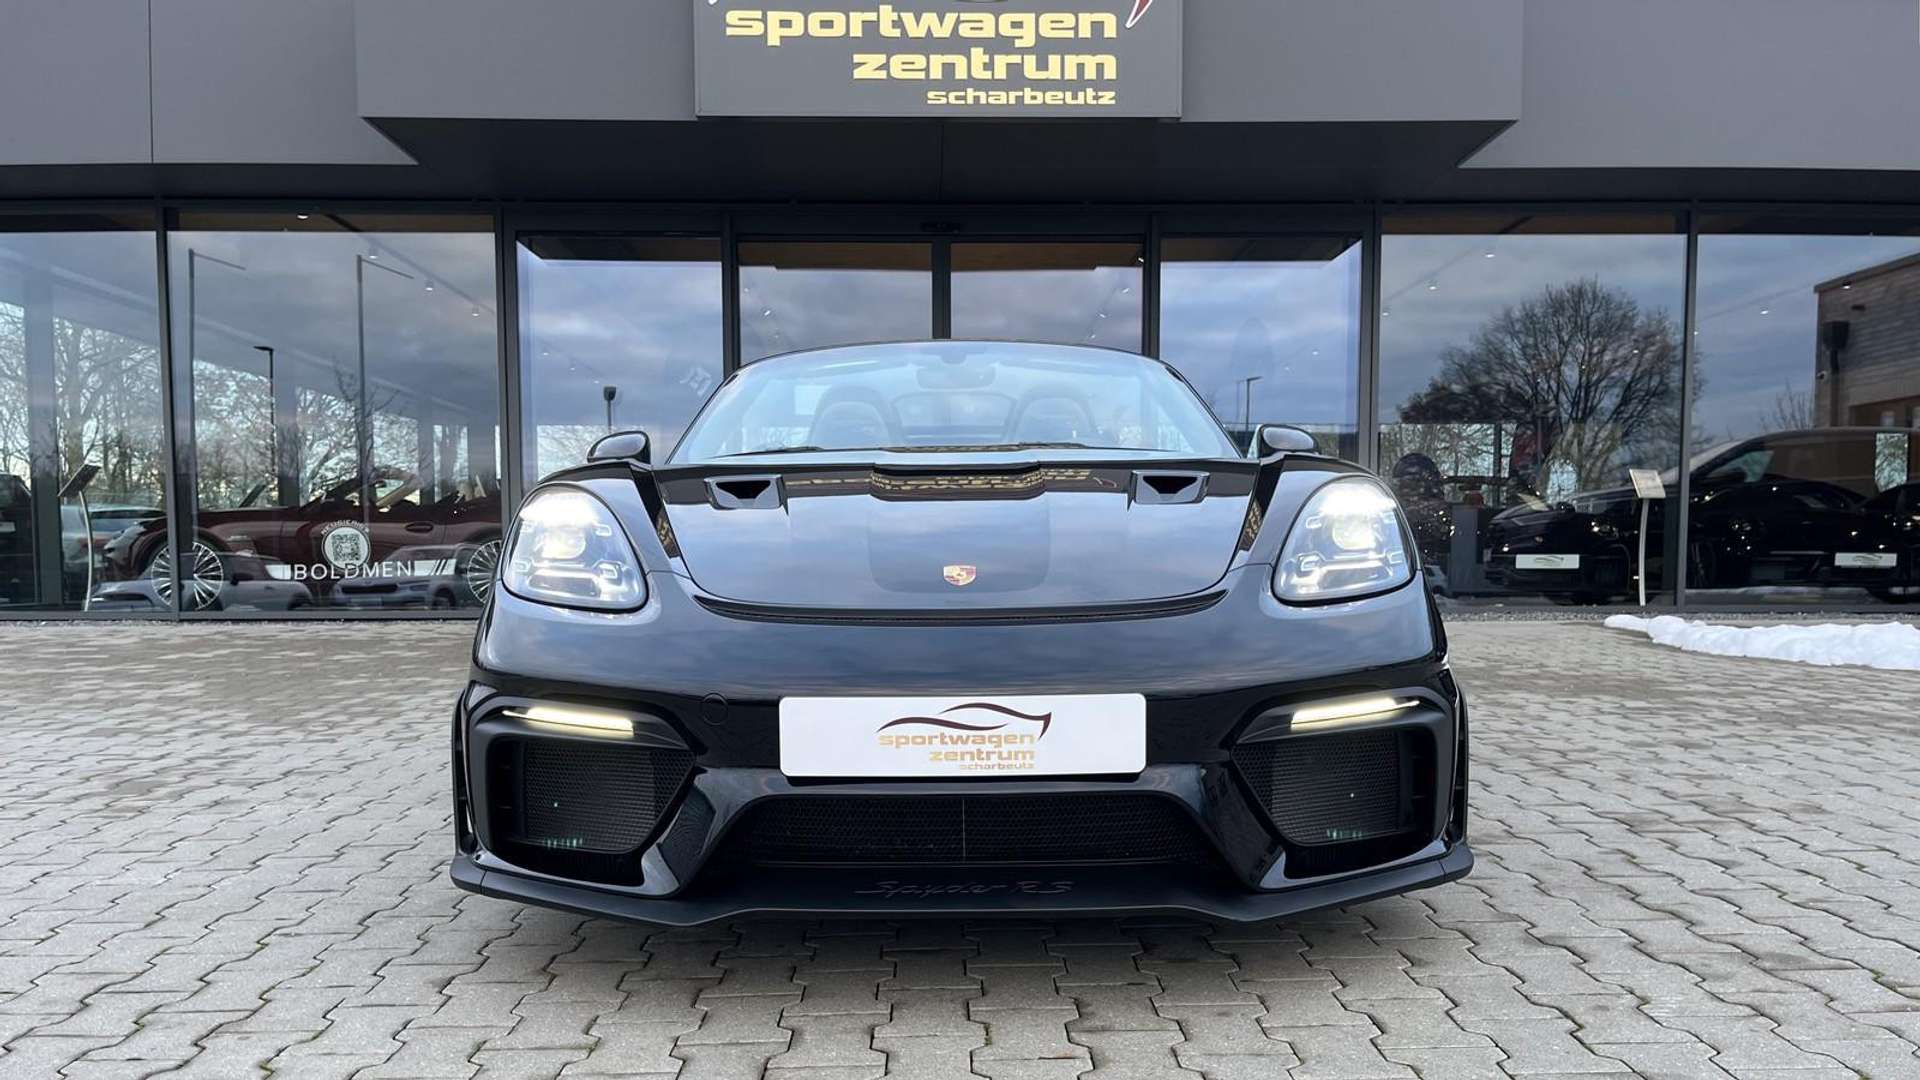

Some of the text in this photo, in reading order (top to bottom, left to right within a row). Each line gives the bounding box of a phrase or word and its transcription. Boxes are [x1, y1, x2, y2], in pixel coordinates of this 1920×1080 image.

[726, 5, 1117, 47] sportwagen
[853, 48, 1117, 80] zentrum
[927, 88, 1116, 105] scharbeutz
[294, 562, 412, 580] BOLDMEN
[878, 732, 1035, 749] sportwagen
[929, 748, 1035, 761] zentrum
[959, 762, 1034, 770] scharbeutz
[854, 881, 1008, 898] Spyder
